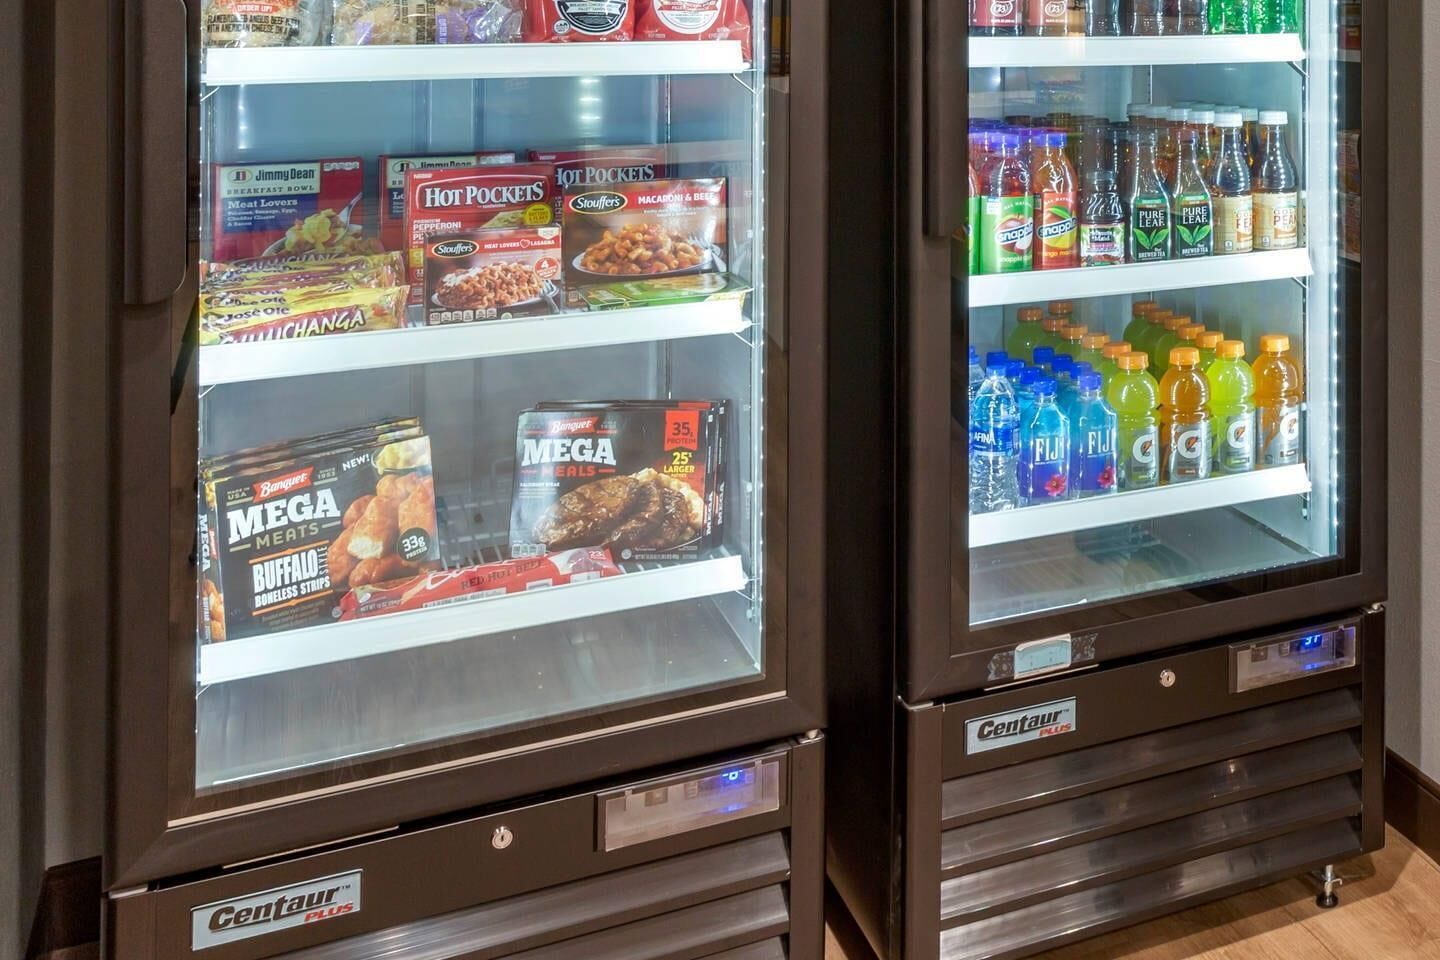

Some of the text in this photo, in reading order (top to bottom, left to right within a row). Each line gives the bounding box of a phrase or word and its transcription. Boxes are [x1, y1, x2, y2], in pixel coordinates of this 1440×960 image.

[256, 169, 315, 181] Jimmy Dean
[585, 164, 655, 185] POCKETS
[227, 187, 283, 195] BREAKFAST
[425, 181, 544, 207] HOT POCKETS
[638, 193, 693, 204] MACARONI &
[228, 198, 298, 209] Meat Lovers
[576, 195, 620, 210] Stouffer's
[1182, 206, 1207, 216] PURE
[1139, 210, 1164, 218] PURE
[1139, 218, 1165, 227] LEAF
[1182, 215, 1208, 224] LEAF
[413, 222, 461, 231] PEPPERONI
[438, 243, 473, 254] Stouffer's
[552, 419, 593, 433] Banquet
[1035, 437, 1064, 462] FIJI
[1088, 429, 1116, 455] FIJI
[521, 438, 616, 467] MEGA
[342, 454, 370, 471] NEW!
[541, 465, 595, 477] MEALS
[664, 465, 695, 473] LARGER
[260, 473, 307, 498] Banquet
[227, 492, 247, 500] USA
[227, 488, 341, 545] MEGA
[706, 490, 714, 535] MEGA
[199, 514, 211, 572] MEGA
[256, 523, 319, 550] MEATS
[402, 535, 426, 553] 33g
[319, 545, 329, 576] STYLE
[406, 545, 428, 559] PROTEIN
[252, 550, 319, 594] BUFFALO
[461, 576, 485, 590] RED
[516, 559, 545, 574] BEEF
[255, 576, 330, 608] BONELESS STRIPS
[977, 709, 1063, 741] Centaur
[1038, 722, 1072, 737] PLUS
[209, 885, 341, 932] Centaur
[304, 902, 354, 923] PLUS
